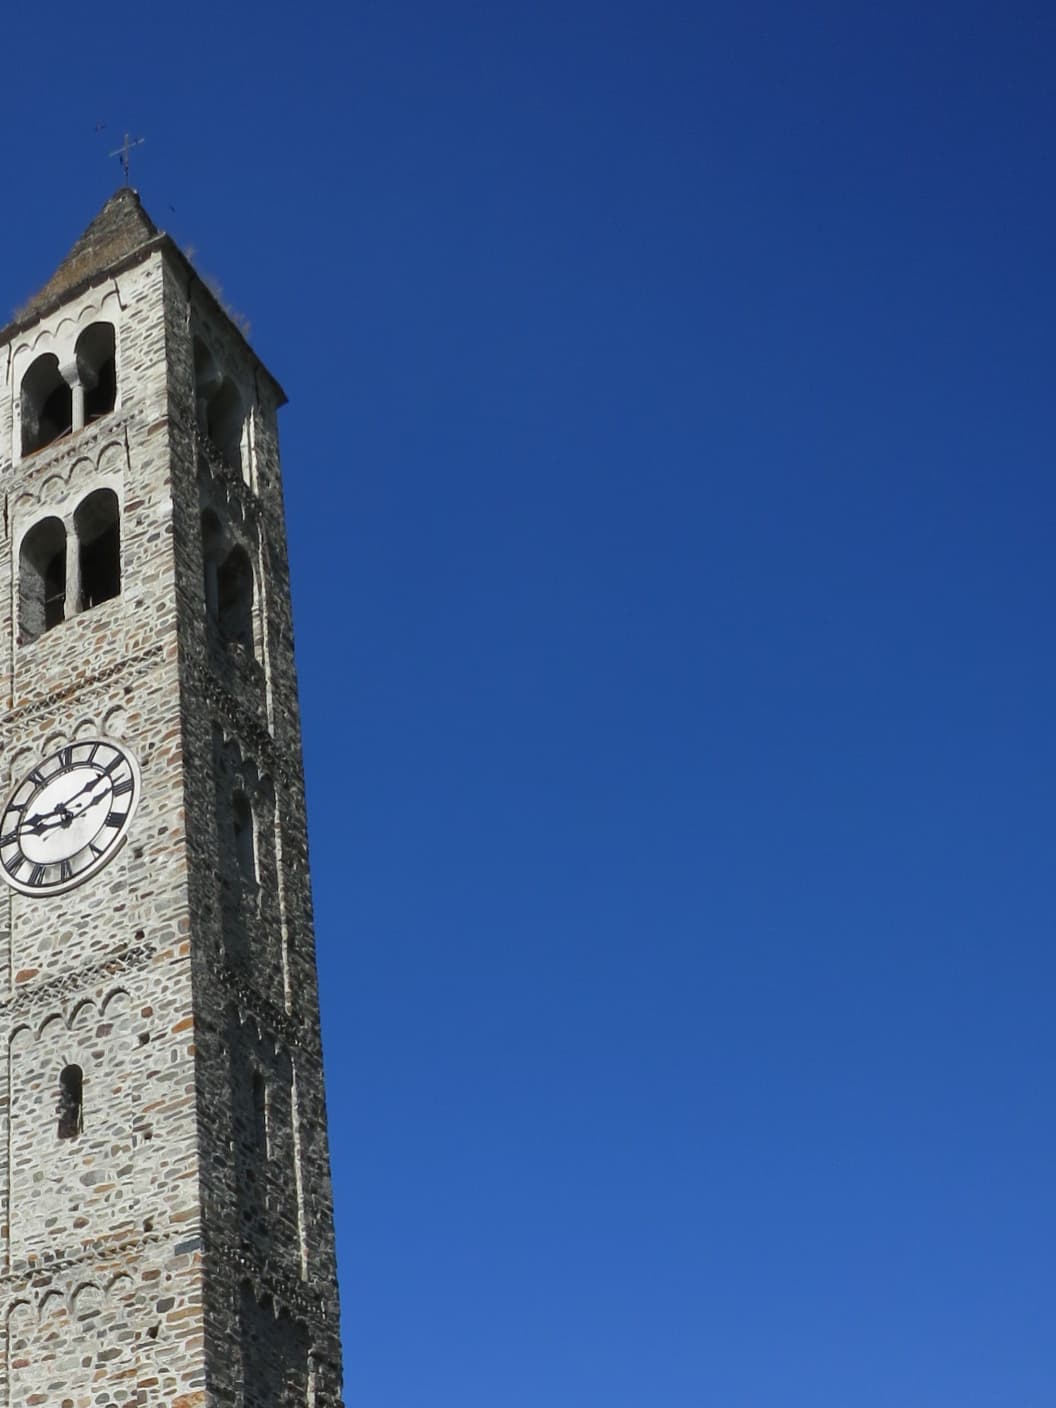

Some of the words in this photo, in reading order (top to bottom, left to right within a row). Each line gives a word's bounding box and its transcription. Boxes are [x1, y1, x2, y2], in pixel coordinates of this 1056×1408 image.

[88, 843, 104, 861] V
[27, 863, 46, 886] VII
[60, 859, 73, 881] VI
